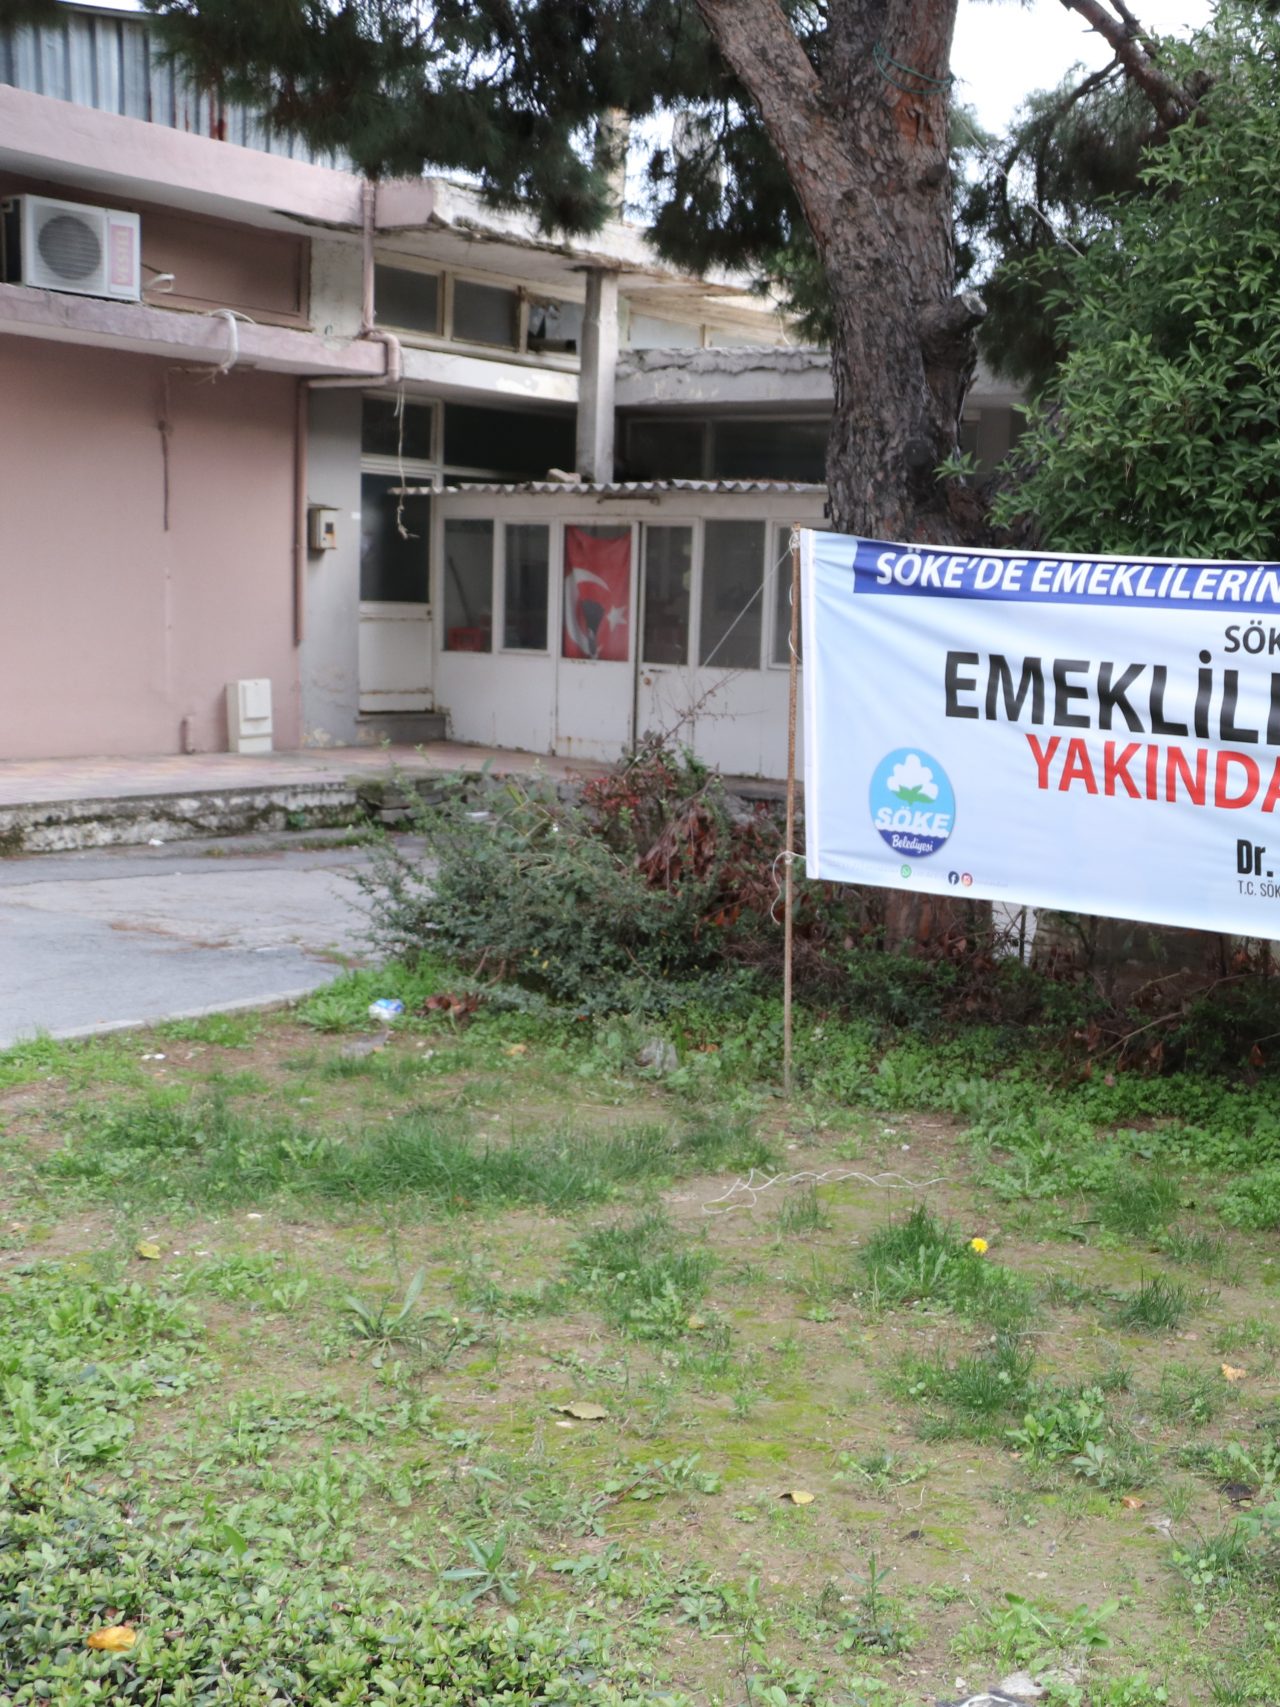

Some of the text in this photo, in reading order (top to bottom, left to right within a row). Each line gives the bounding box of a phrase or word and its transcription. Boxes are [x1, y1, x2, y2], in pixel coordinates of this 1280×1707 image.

[876, 548, 1028, 591] SÖKE'DE
[876, 806, 950, 831] SÖKE
[892, 834, 934, 853] Belediyesi
[1237, 839, 1274, 878] Dr.
[1238, 880, 1257, 896] T.C.
